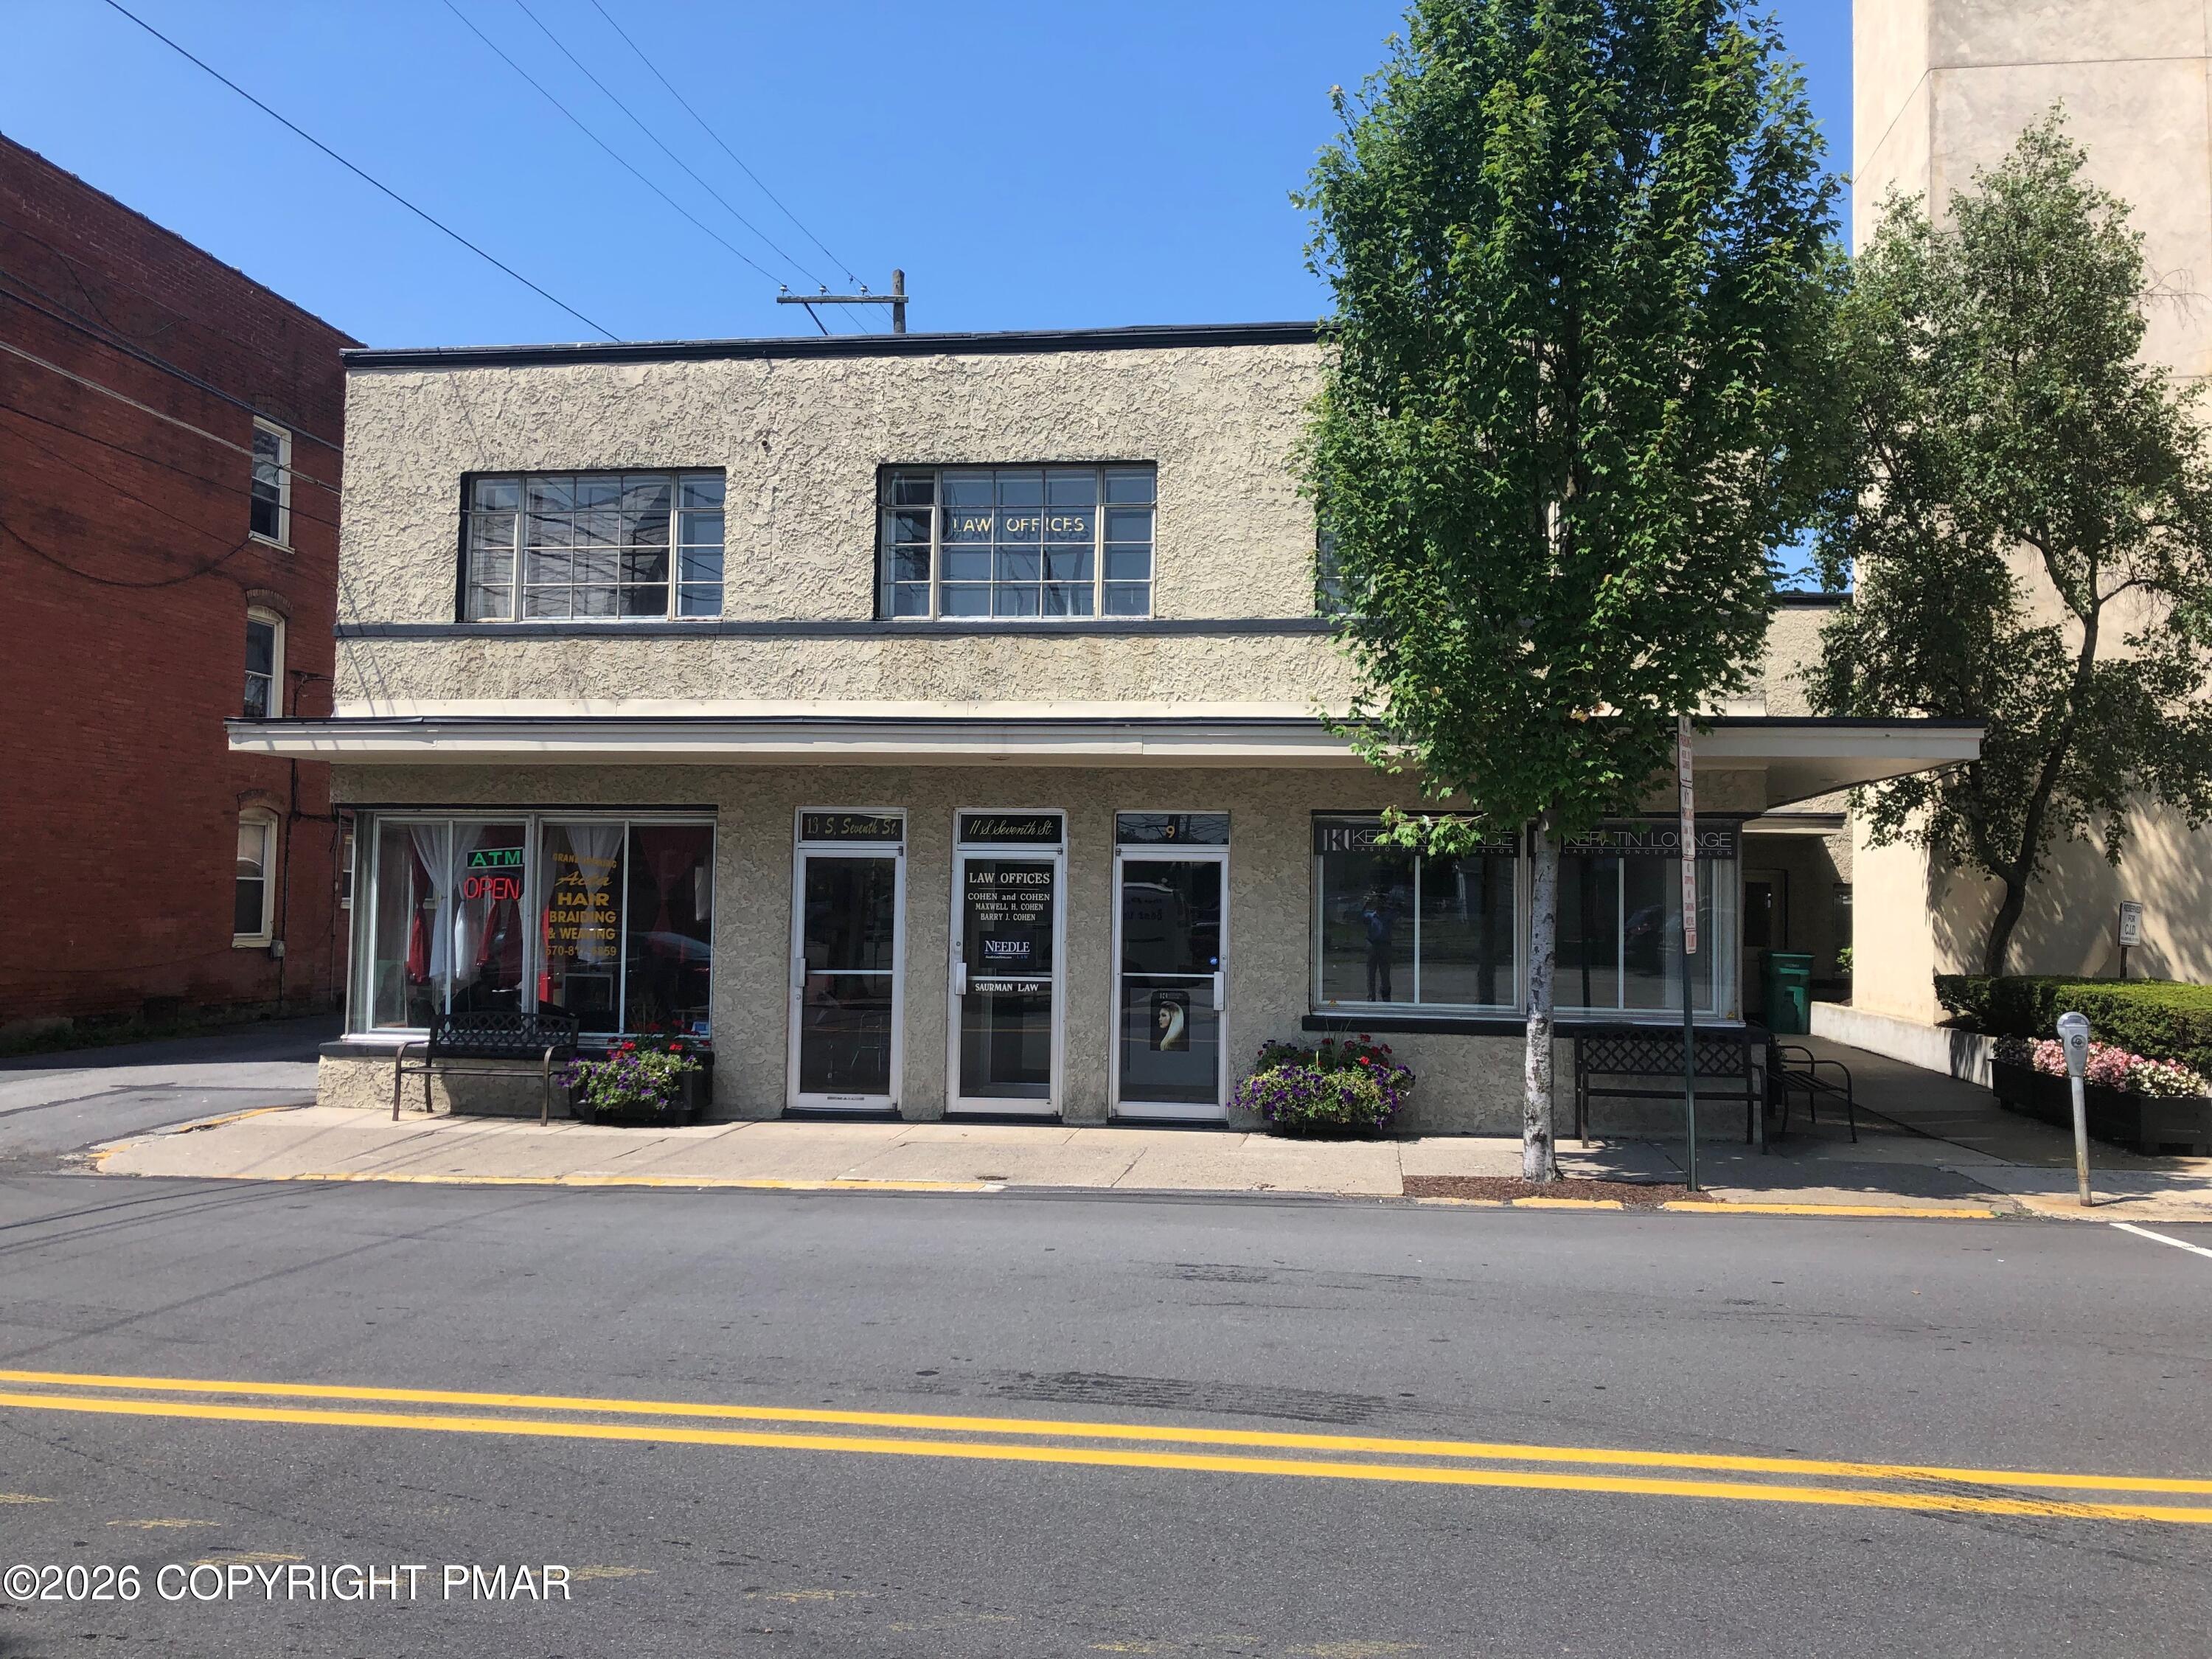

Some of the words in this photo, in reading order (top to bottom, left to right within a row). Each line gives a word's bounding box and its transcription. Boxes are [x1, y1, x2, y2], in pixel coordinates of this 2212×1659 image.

[953, 518, 992, 532] LAW
[1006, 517, 1085, 532] OFFICES
[807, 816, 819, 833] 13
[841, 817, 878, 835] Seventh
[969, 819, 981, 835] 11
[991, 819, 1036, 835] Seventh
[1166, 825, 1175, 838] 9
[1652, 832, 1732, 848] LONGE
[471, 850, 521, 866] ATM
[969, 872, 995, 883] LAW
[1000, 872, 1051, 884] OFFICES
[464, 877, 520, 900] OPEN
[557, 892, 610, 906] HAIR
[967, 892, 998, 900] COHEN
[1020, 893, 1050, 901] COHEN
[975, 902, 1008, 911] MAXWELL
[549, 910, 616, 923] BRAIDING
[980, 913, 1004, 921] BARRY
[1005, 913, 1010, 921] J.
[548, 927, 556, 939] &
[984, 940, 1030, 953] NEEDLE
[975, 983, 1013, 992] SAURMAN
[1018, 983, 1039, 992] LAW
